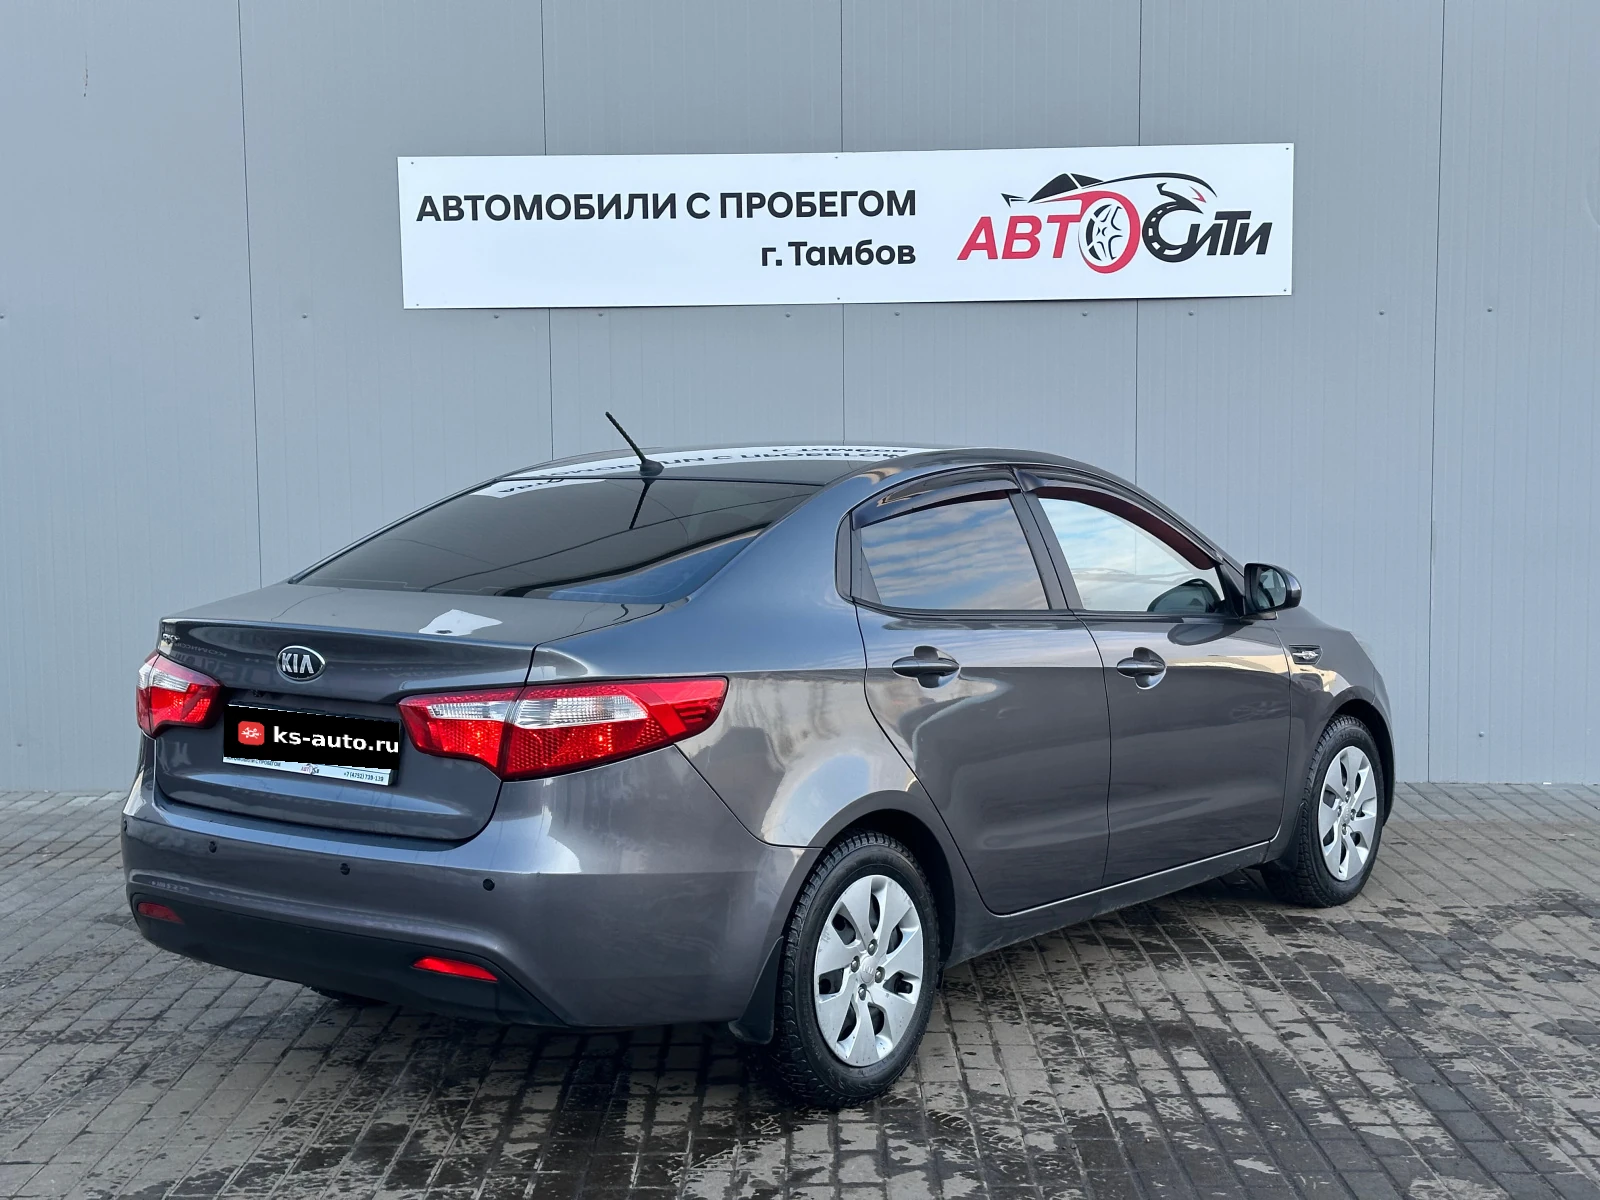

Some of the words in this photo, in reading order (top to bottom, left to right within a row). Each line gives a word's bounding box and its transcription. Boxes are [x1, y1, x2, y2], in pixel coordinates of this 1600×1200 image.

[416, 193, 677, 221] АВТОМОБИЛИ
[687, 192, 711, 219] С
[720, 190, 916, 219] ПРОБЕГОМ
[761, 247, 783, 267] г.
[788, 239, 916, 267] Тамбов
[281, 652, 315, 674] KIA
